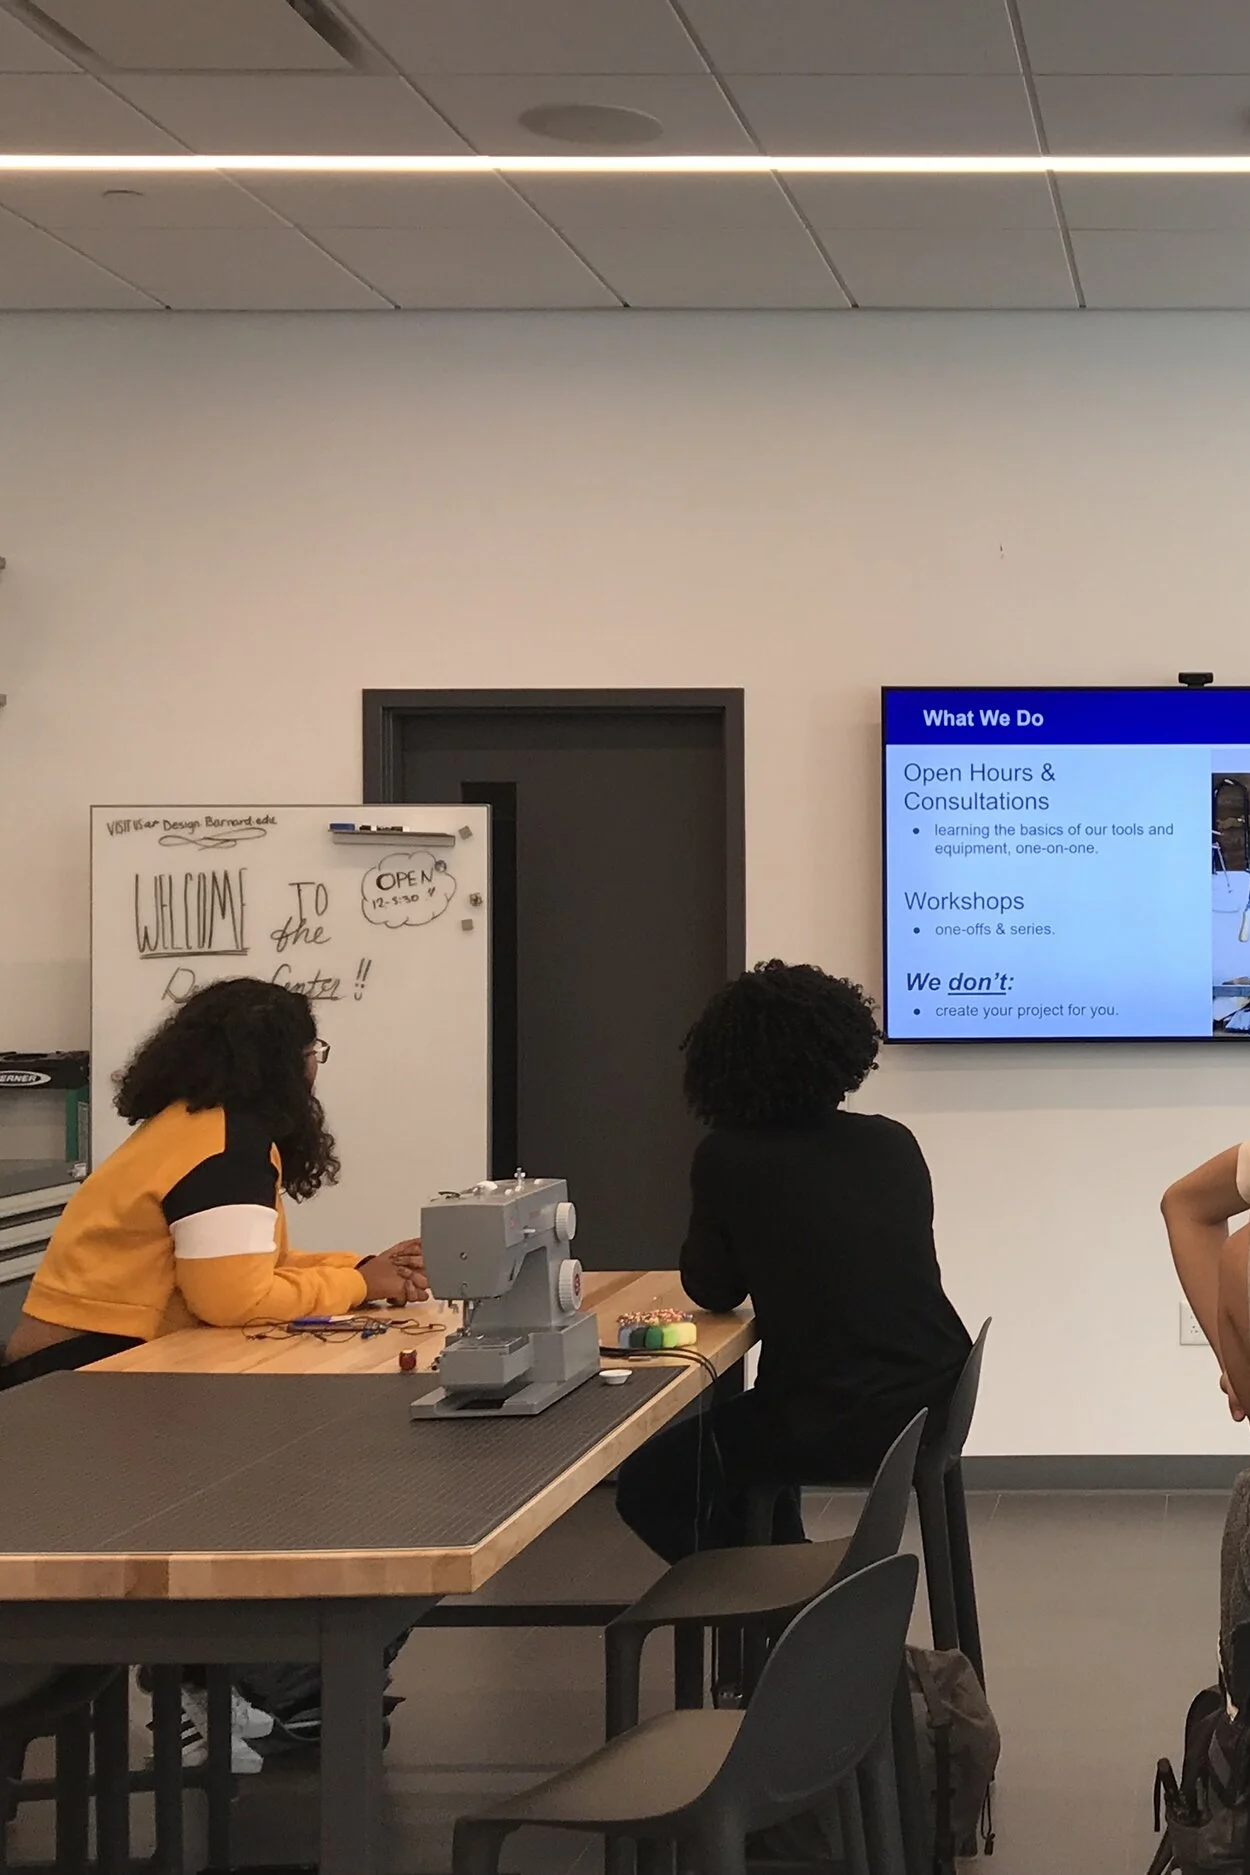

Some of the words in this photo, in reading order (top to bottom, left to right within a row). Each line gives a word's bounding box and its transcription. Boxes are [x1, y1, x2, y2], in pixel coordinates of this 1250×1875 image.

[923, 710, 974, 726] What
[980, 710, 1010, 726] We
[1017, 710, 1043, 726] Do
[904, 763, 961, 786] Open
[971, 763, 1033, 781] Hours
[1041, 763, 1055, 781] &
[904, 792, 1049, 810] Consultations
[935, 824, 989, 839] learning
[994, 824, 1015, 836] the
[1020, 824, 1063, 836] basics
[1068, 823, 1081, 835] of
[1085, 826, 1107, 835] our
[1112, 824, 1144, 835] tools
[1149, 824, 1173, 835] and
[935, 842, 1011, 857] equipment,
[1016, 844, 1098, 854] one-on-one.
[376, 866, 434, 891] OPEN
[135, 868, 250, 954] WELCOME
[288, 881, 328, 922] TO
[904, 892, 1024, 914] Workshops
[270, 916, 331, 952] the
[935, 923, 991, 935] one-offs
[996, 923, 1005, 935] &
[1011, 923, 1055, 935] series.
[907, 973, 941, 991] We
[936, 1005, 978, 1016] create
[983, 1007, 1013, 1019] your
[1018, 1004, 1063, 1019] project
[1068, 1004, 1086, 1016] for
[1090, 1006, 1118, 1019] you.
[0, 1074, 37, 1083] ERNER
